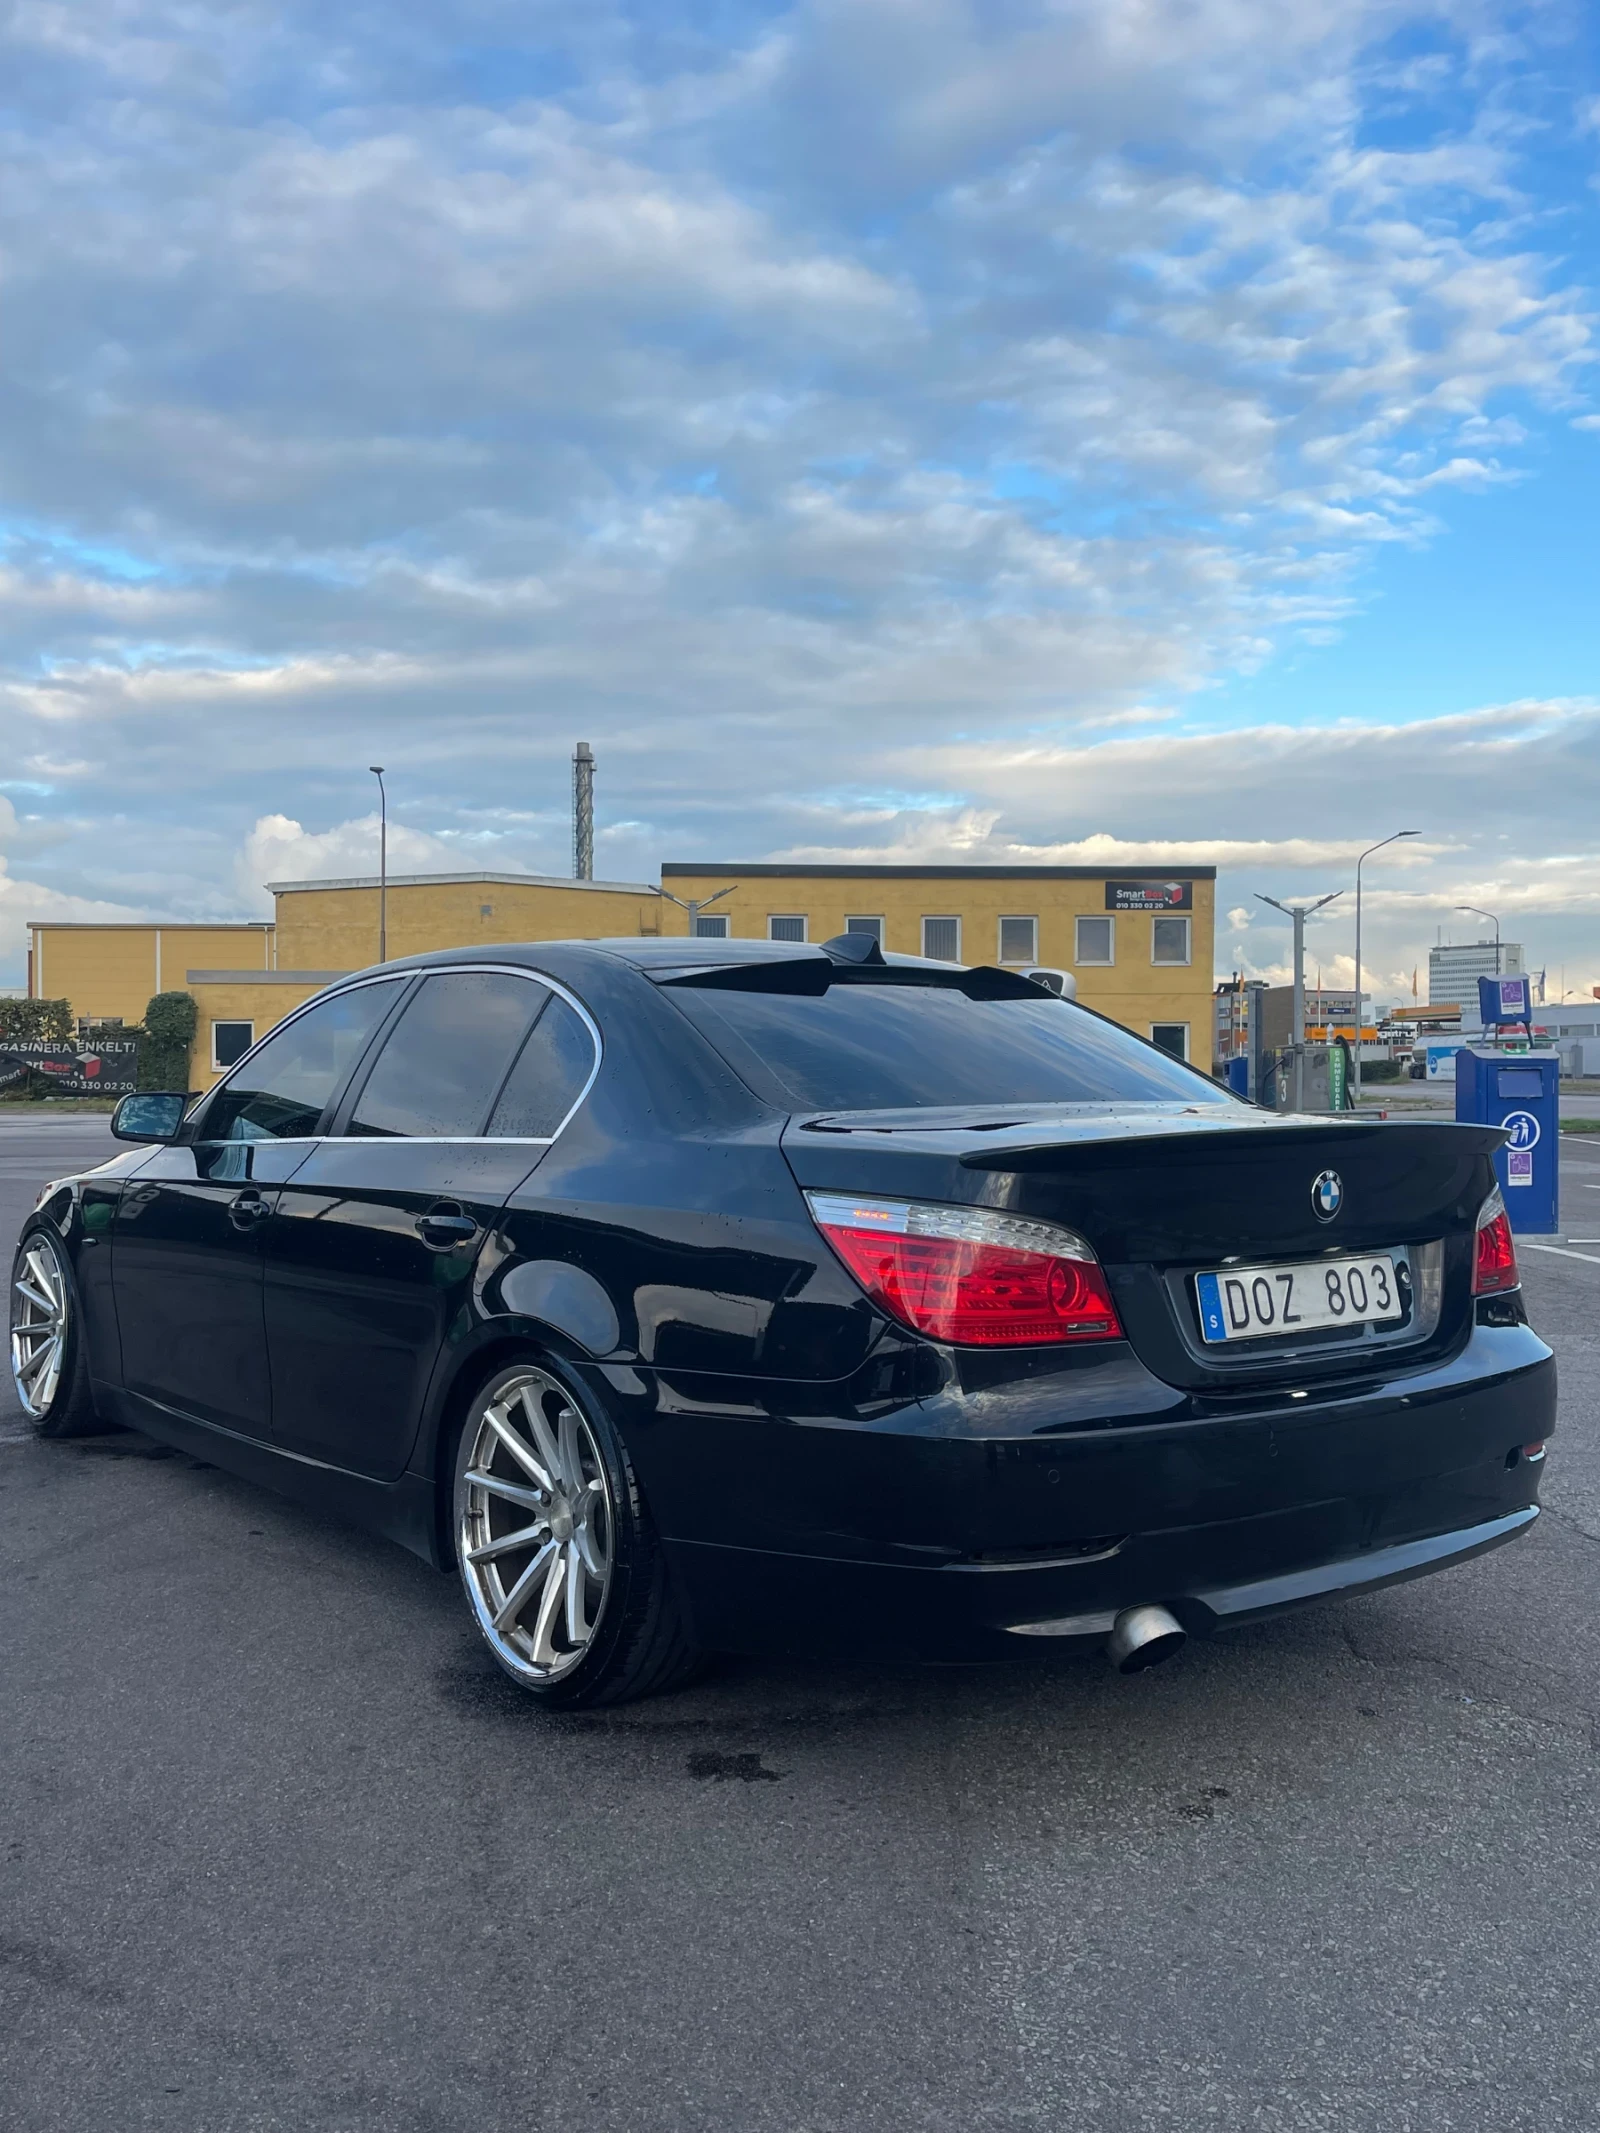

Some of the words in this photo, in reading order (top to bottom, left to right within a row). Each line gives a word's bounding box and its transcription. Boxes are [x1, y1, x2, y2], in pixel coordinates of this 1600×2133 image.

[1116, 889, 1163, 898] SmartBox
[0, 1042, 72, 1053] GASINERA
[77, 1041, 136, 1053] ENKELT!
[81, 1081, 101, 1090] 330
[104, 1082, 117, 1090] 02
[120, 1082, 133, 1090] 20
[1281, 1080, 1287, 1102] 3
[1225, 1274, 1301, 1330] DOZ
[1325, 1264, 1391, 1316] 803
[1210, 1315, 1218, 1329] S
